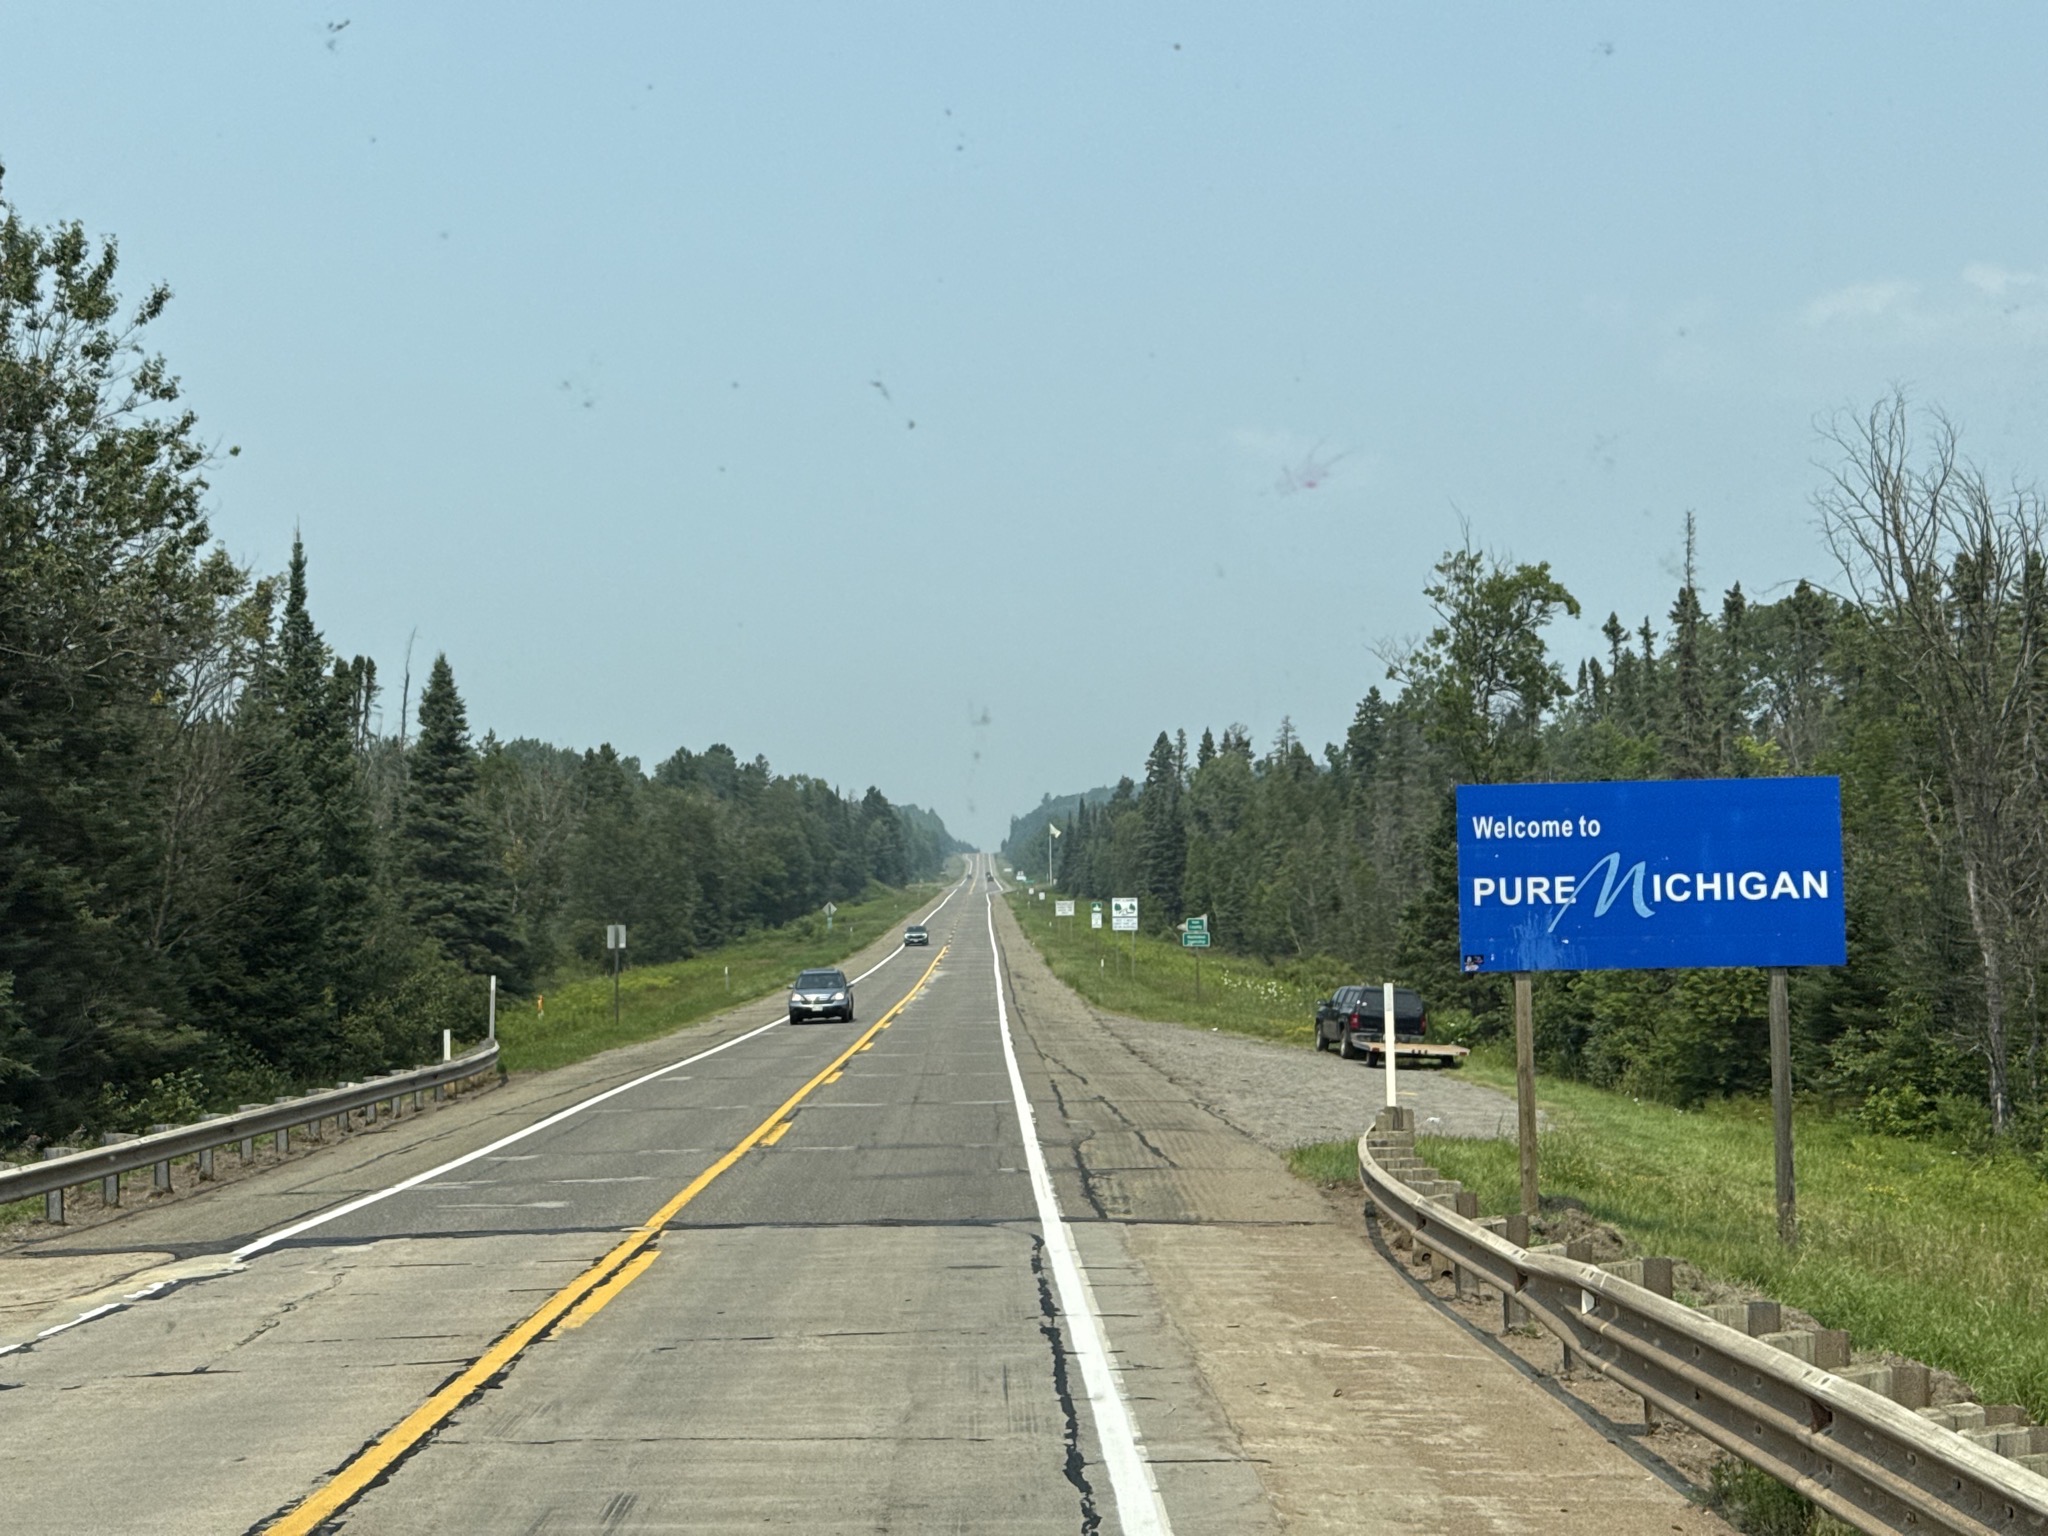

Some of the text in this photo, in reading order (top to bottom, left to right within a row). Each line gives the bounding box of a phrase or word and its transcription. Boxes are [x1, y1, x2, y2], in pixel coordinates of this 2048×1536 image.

[1472, 815, 1601, 840] Welcome to
[1473, 851, 1828, 933] PURE MICHIGAN
